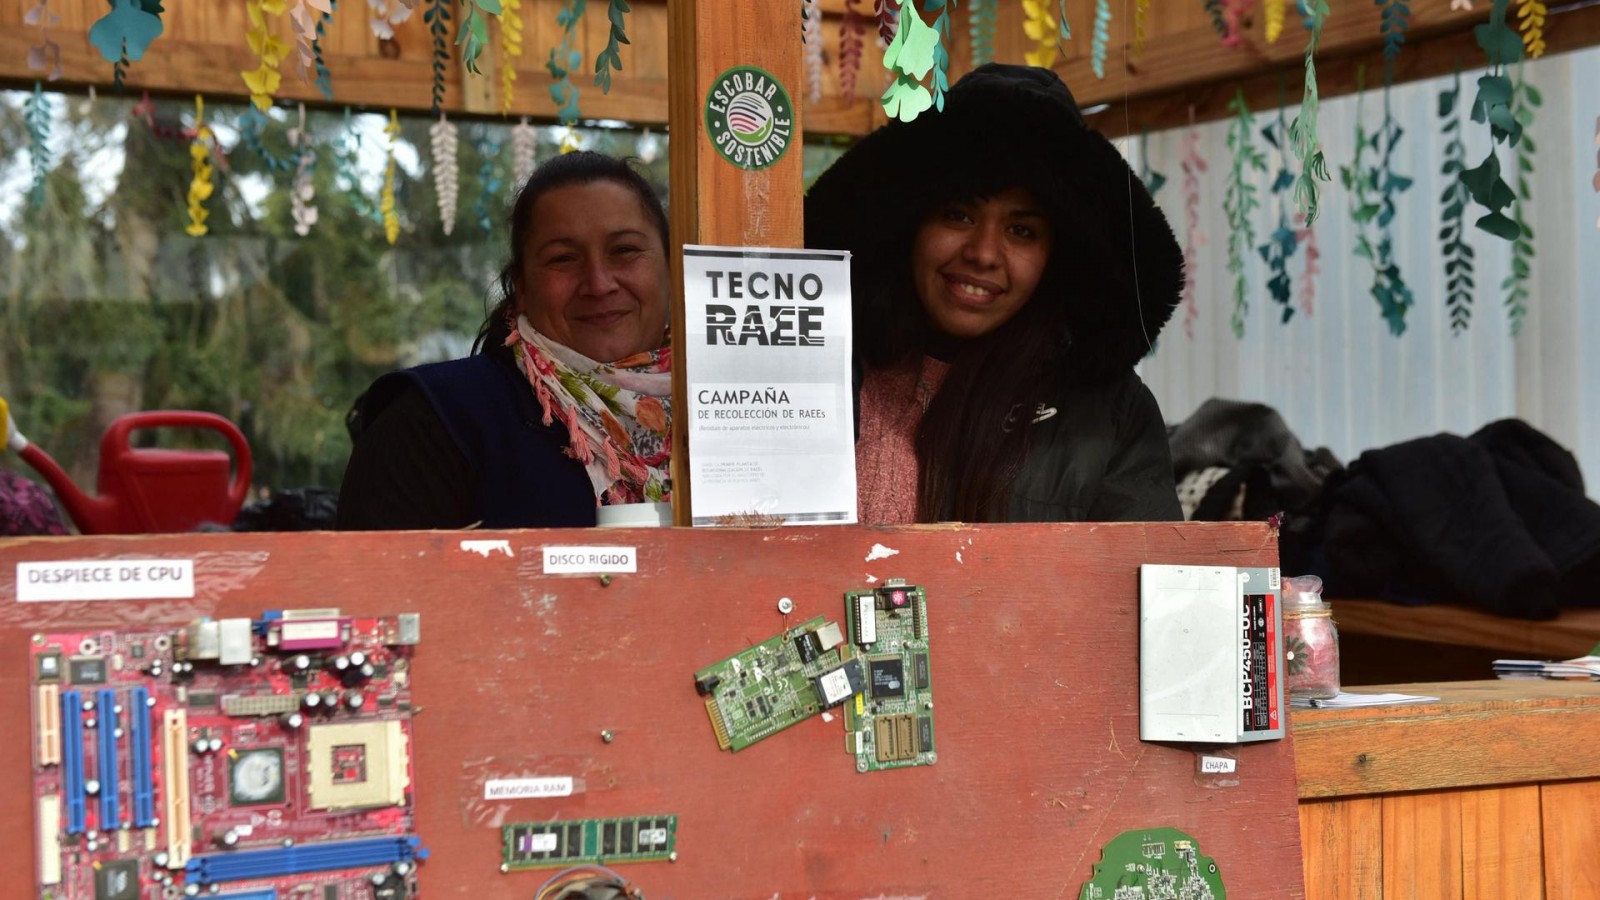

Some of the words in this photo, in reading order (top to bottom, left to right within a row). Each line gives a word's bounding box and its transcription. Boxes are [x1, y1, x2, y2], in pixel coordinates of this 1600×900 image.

[710, 72, 777, 113] ESCOBAR
[716, 118, 790, 165] SOSTENIBLE
[705, 270, 823, 301] TECNO
[705, 304, 825, 347] RAEE
[697, 387, 791, 405] CAMPAÑA
[698, 409, 710, 419] DE
[714, 408, 778, 419] RECOLECCIÓN
[782, 409, 795, 419] DE
[799, 409, 826, 419] RAEEs
[549, 554, 585, 565] DISCO
[589, 554, 629, 565] RIGIDO
[27, 568, 113, 584] DESPIECE
[119, 567, 142, 582] DE
[147, 566, 183, 581] CPU
[1205, 761, 1229, 770] CHAPA
[489, 785, 541, 796] MEMORIA
[543, 783, 566, 792] RAM
